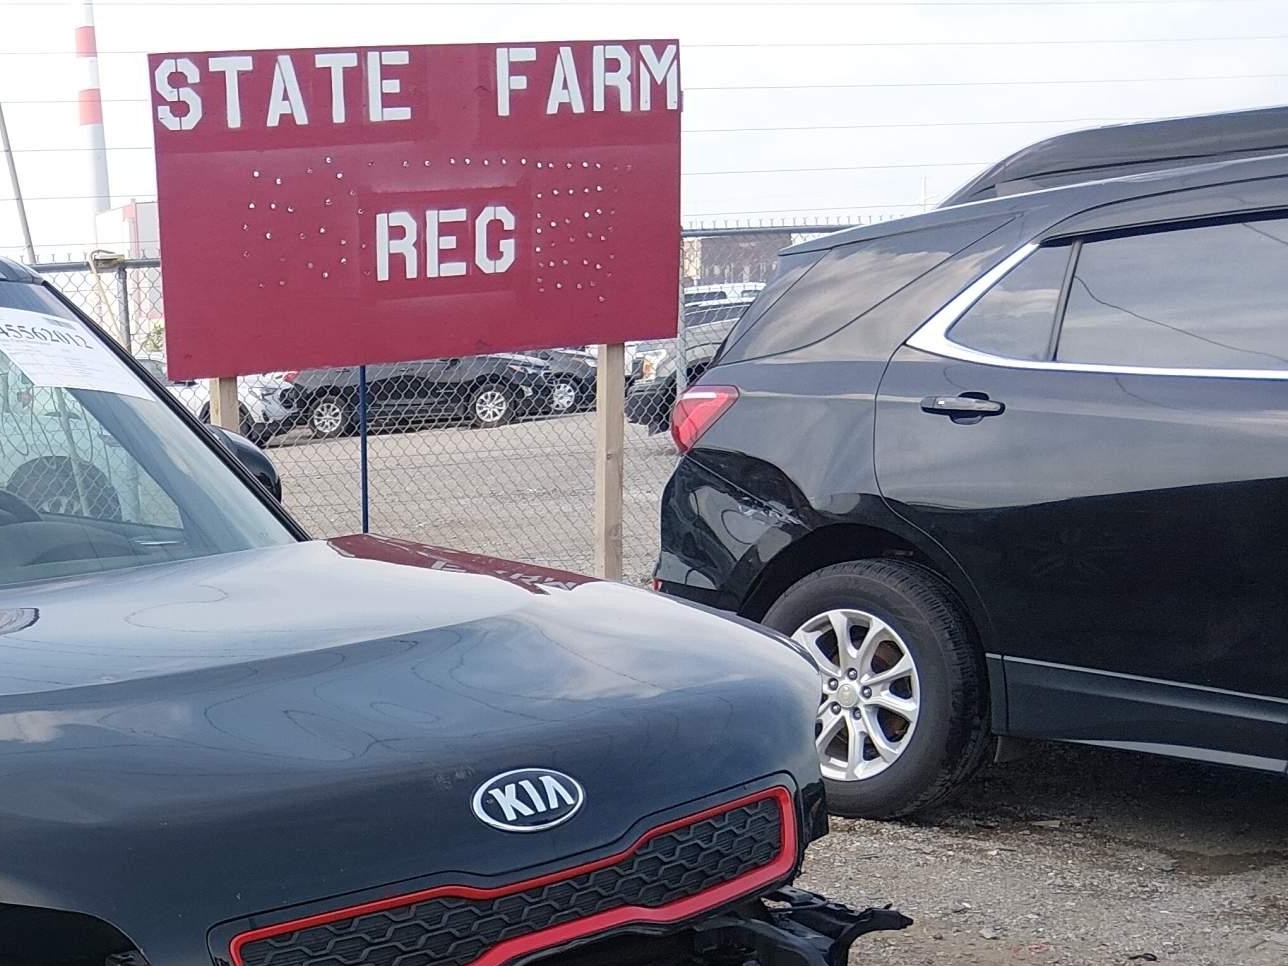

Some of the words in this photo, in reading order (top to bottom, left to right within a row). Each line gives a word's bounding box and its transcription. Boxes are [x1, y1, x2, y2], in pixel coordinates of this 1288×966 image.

[155, 50, 411, 131] STATE
[497, 44, 677, 116] FARM
[376, 206, 515, 281] REG
[488, 775, 575, 821] KIA
